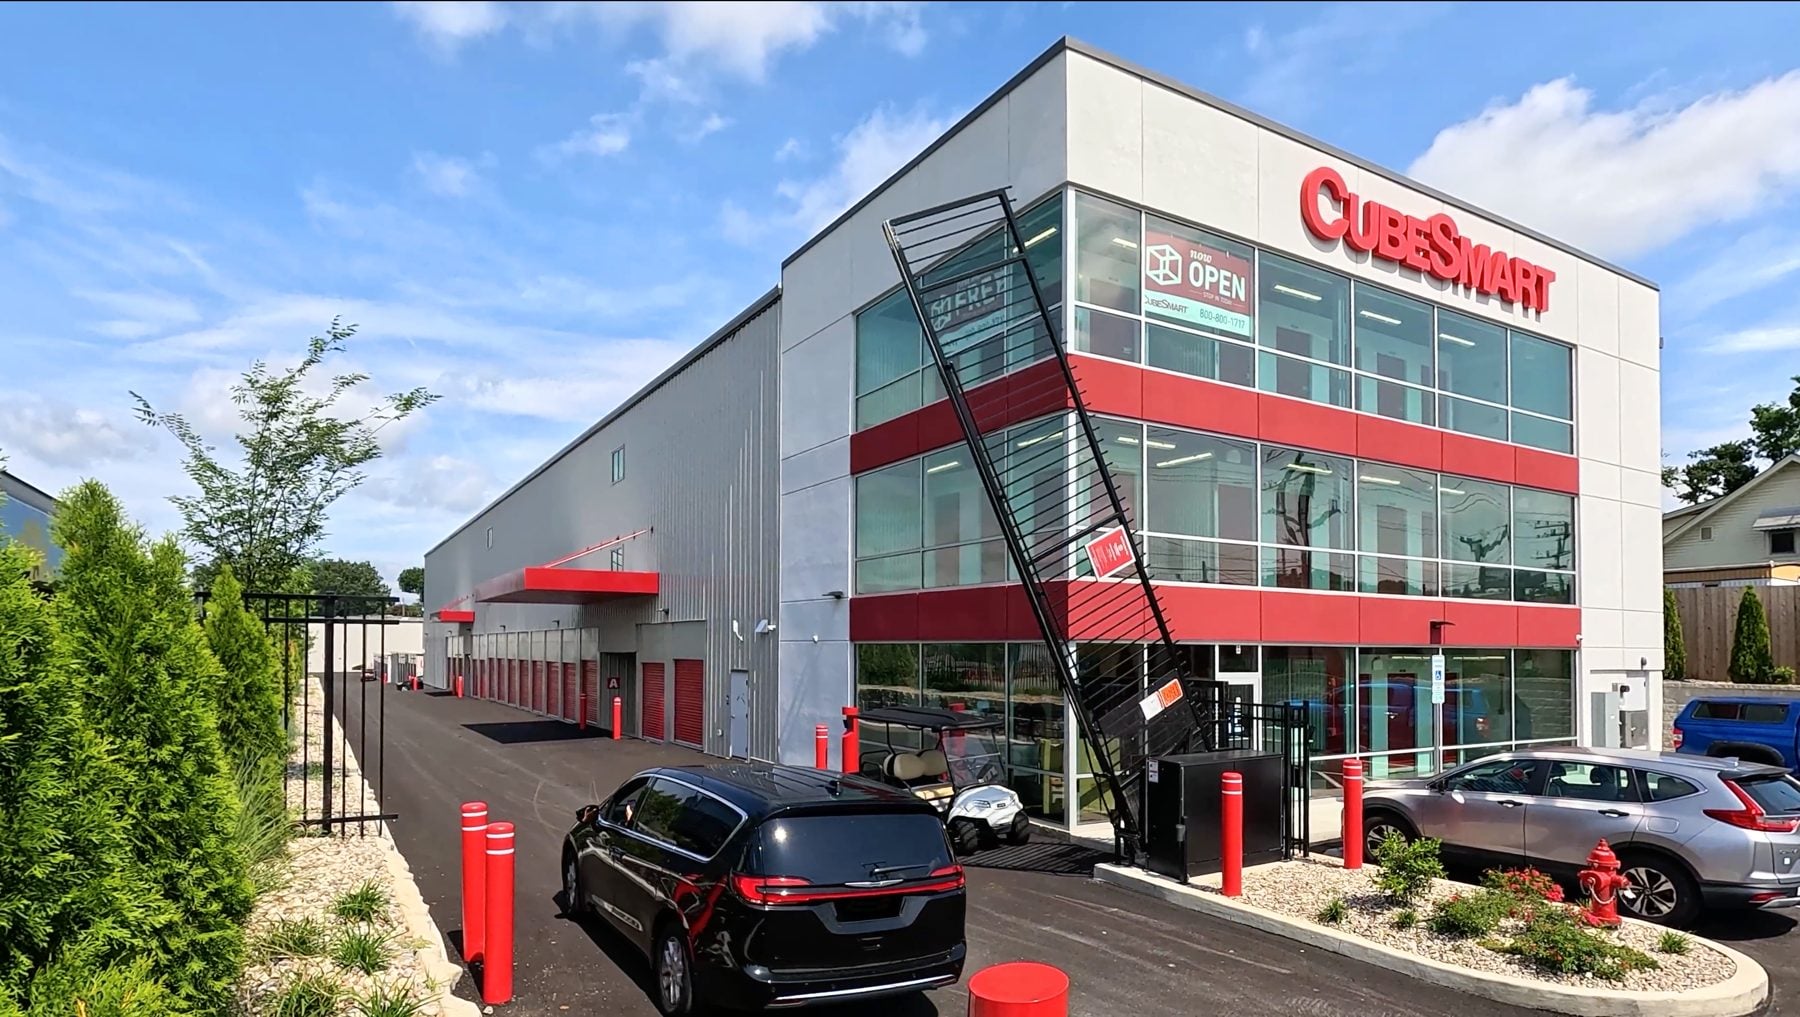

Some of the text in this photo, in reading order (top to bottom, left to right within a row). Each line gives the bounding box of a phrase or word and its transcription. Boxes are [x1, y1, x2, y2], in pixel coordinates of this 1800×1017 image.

[1189, 249, 1213, 264] now
[1188, 261, 1246, 302] OPEN
[1199, 308, 1246, 329] 800-800-1717
[609, 678, 618, 688] A
